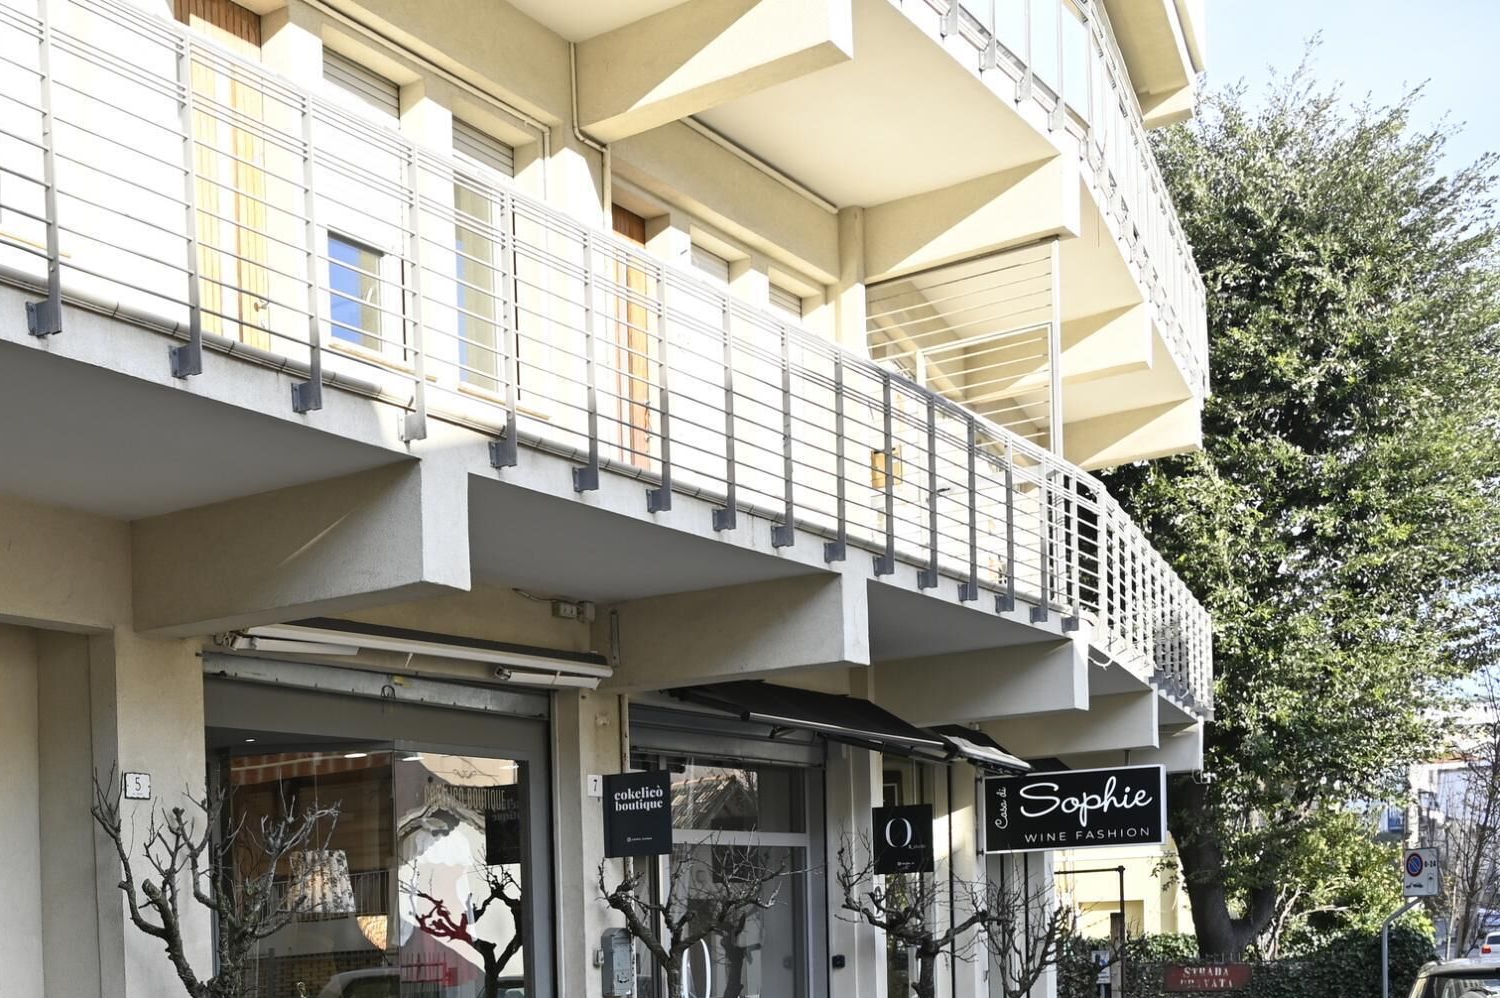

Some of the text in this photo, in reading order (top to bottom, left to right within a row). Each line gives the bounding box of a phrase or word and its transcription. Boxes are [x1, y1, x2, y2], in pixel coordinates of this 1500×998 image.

[135, 776, 142, 791] 5
[593, 779, 598, 792] 7
[467, 787, 505, 813] BOUTIQUE
[614, 784, 664, 801] cokelicò
[615, 799, 664, 812] boutique
[1019, 775, 1153, 827] Sophie
[1024, 827, 1150, 843] WINE FASHION
